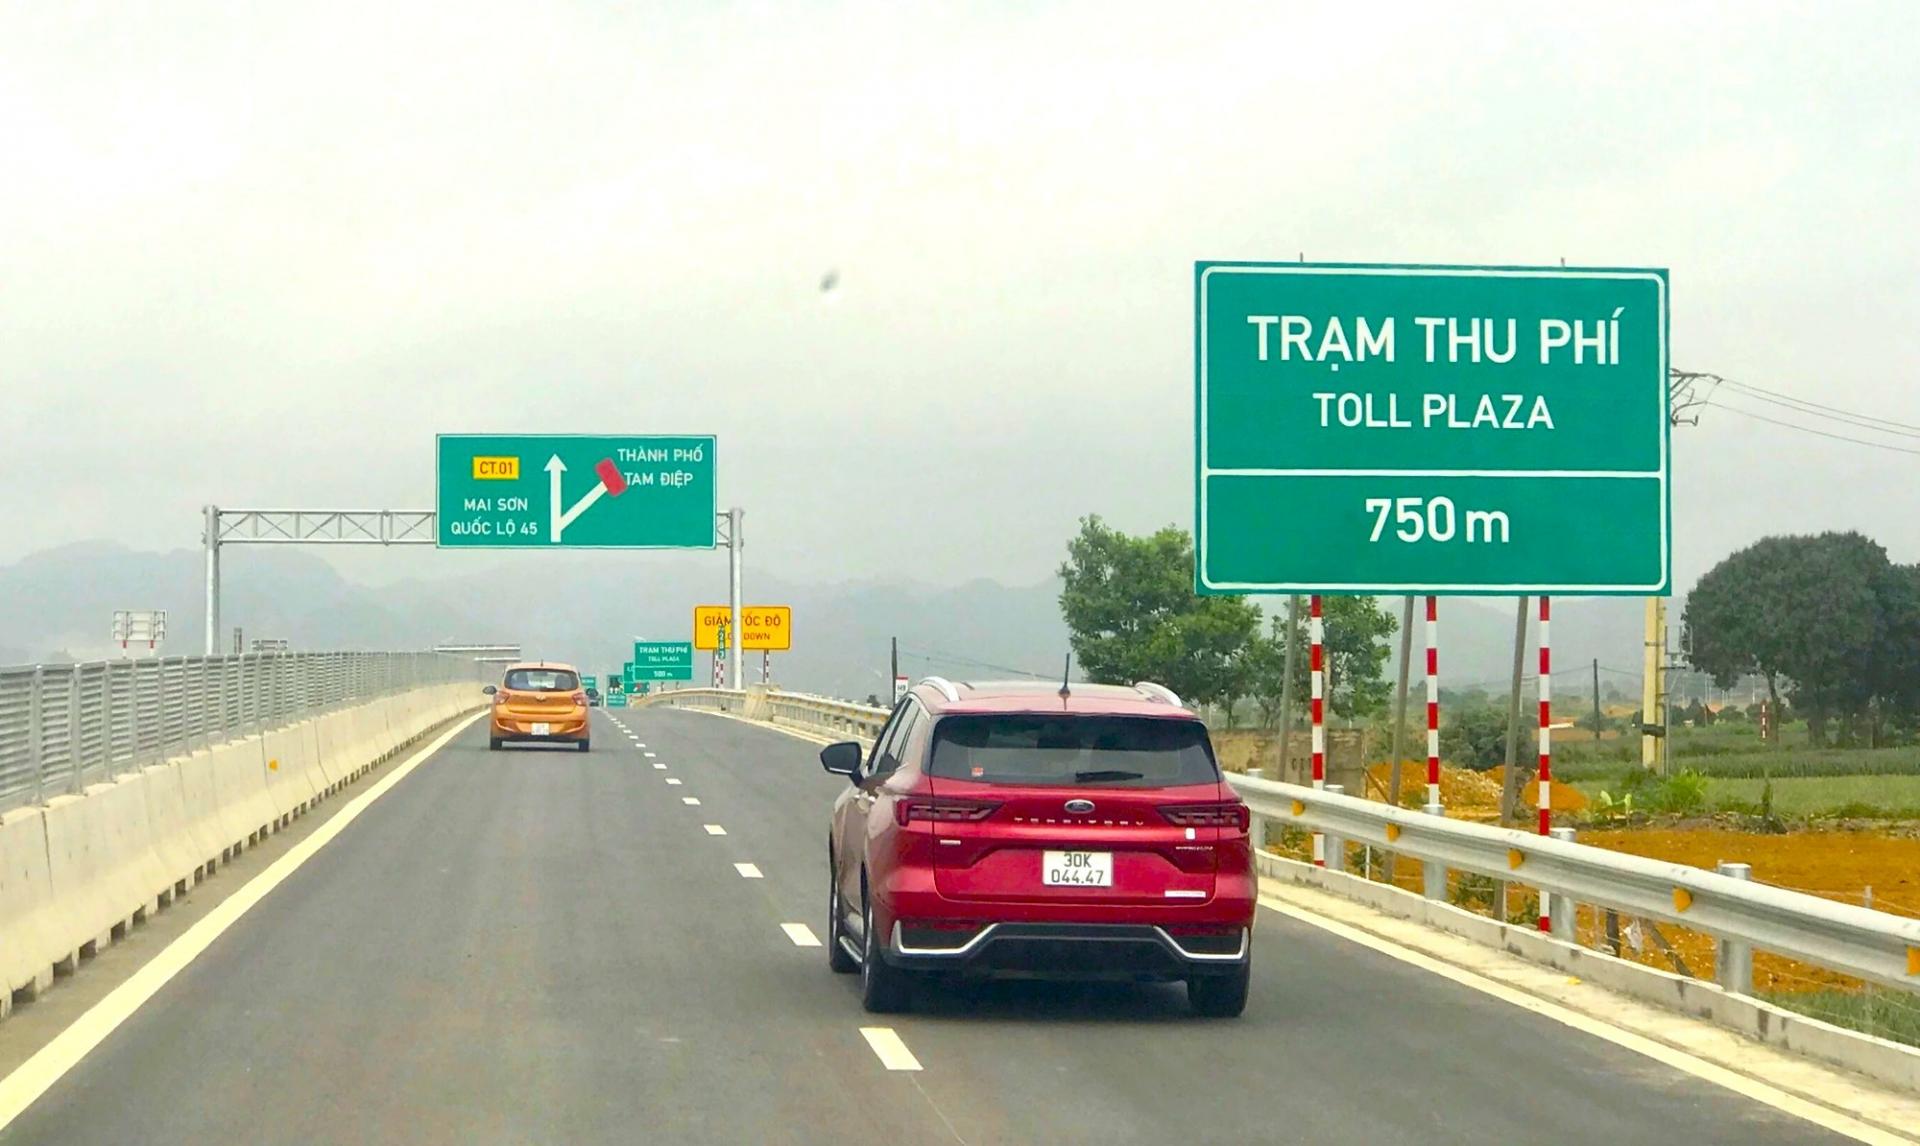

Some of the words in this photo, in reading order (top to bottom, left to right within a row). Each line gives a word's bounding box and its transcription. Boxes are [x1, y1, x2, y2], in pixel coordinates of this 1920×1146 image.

[1247, 315, 1395, 371] TRẠM
[1414, 317, 1517, 364] THU
[1540, 307, 1625, 365] PHÍ
[1312, 392, 1412, 428] TOLL
[1423, 393, 1555, 429] PLAZA
[617, 446, 668, 462] THÀNH
[673, 443, 703, 462] PHỐ
[479, 460, 513, 475] CT.01
[624, 472, 654, 486] TAM
[660, 469, 693, 488] ĐIỆP
[464, 498, 491, 512] MAI
[497, 496, 528, 512] SƠN
[451, 516, 491, 535] QUỐC
[496, 518, 516, 537] LỘ
[520, 522, 538, 535] 45
[1365, 496, 1456, 543] 750
[1466, 510, 1510, 543] m
[1063, 852, 1092, 868] 30K
[1051, 869, 1104, 884] 044.47
